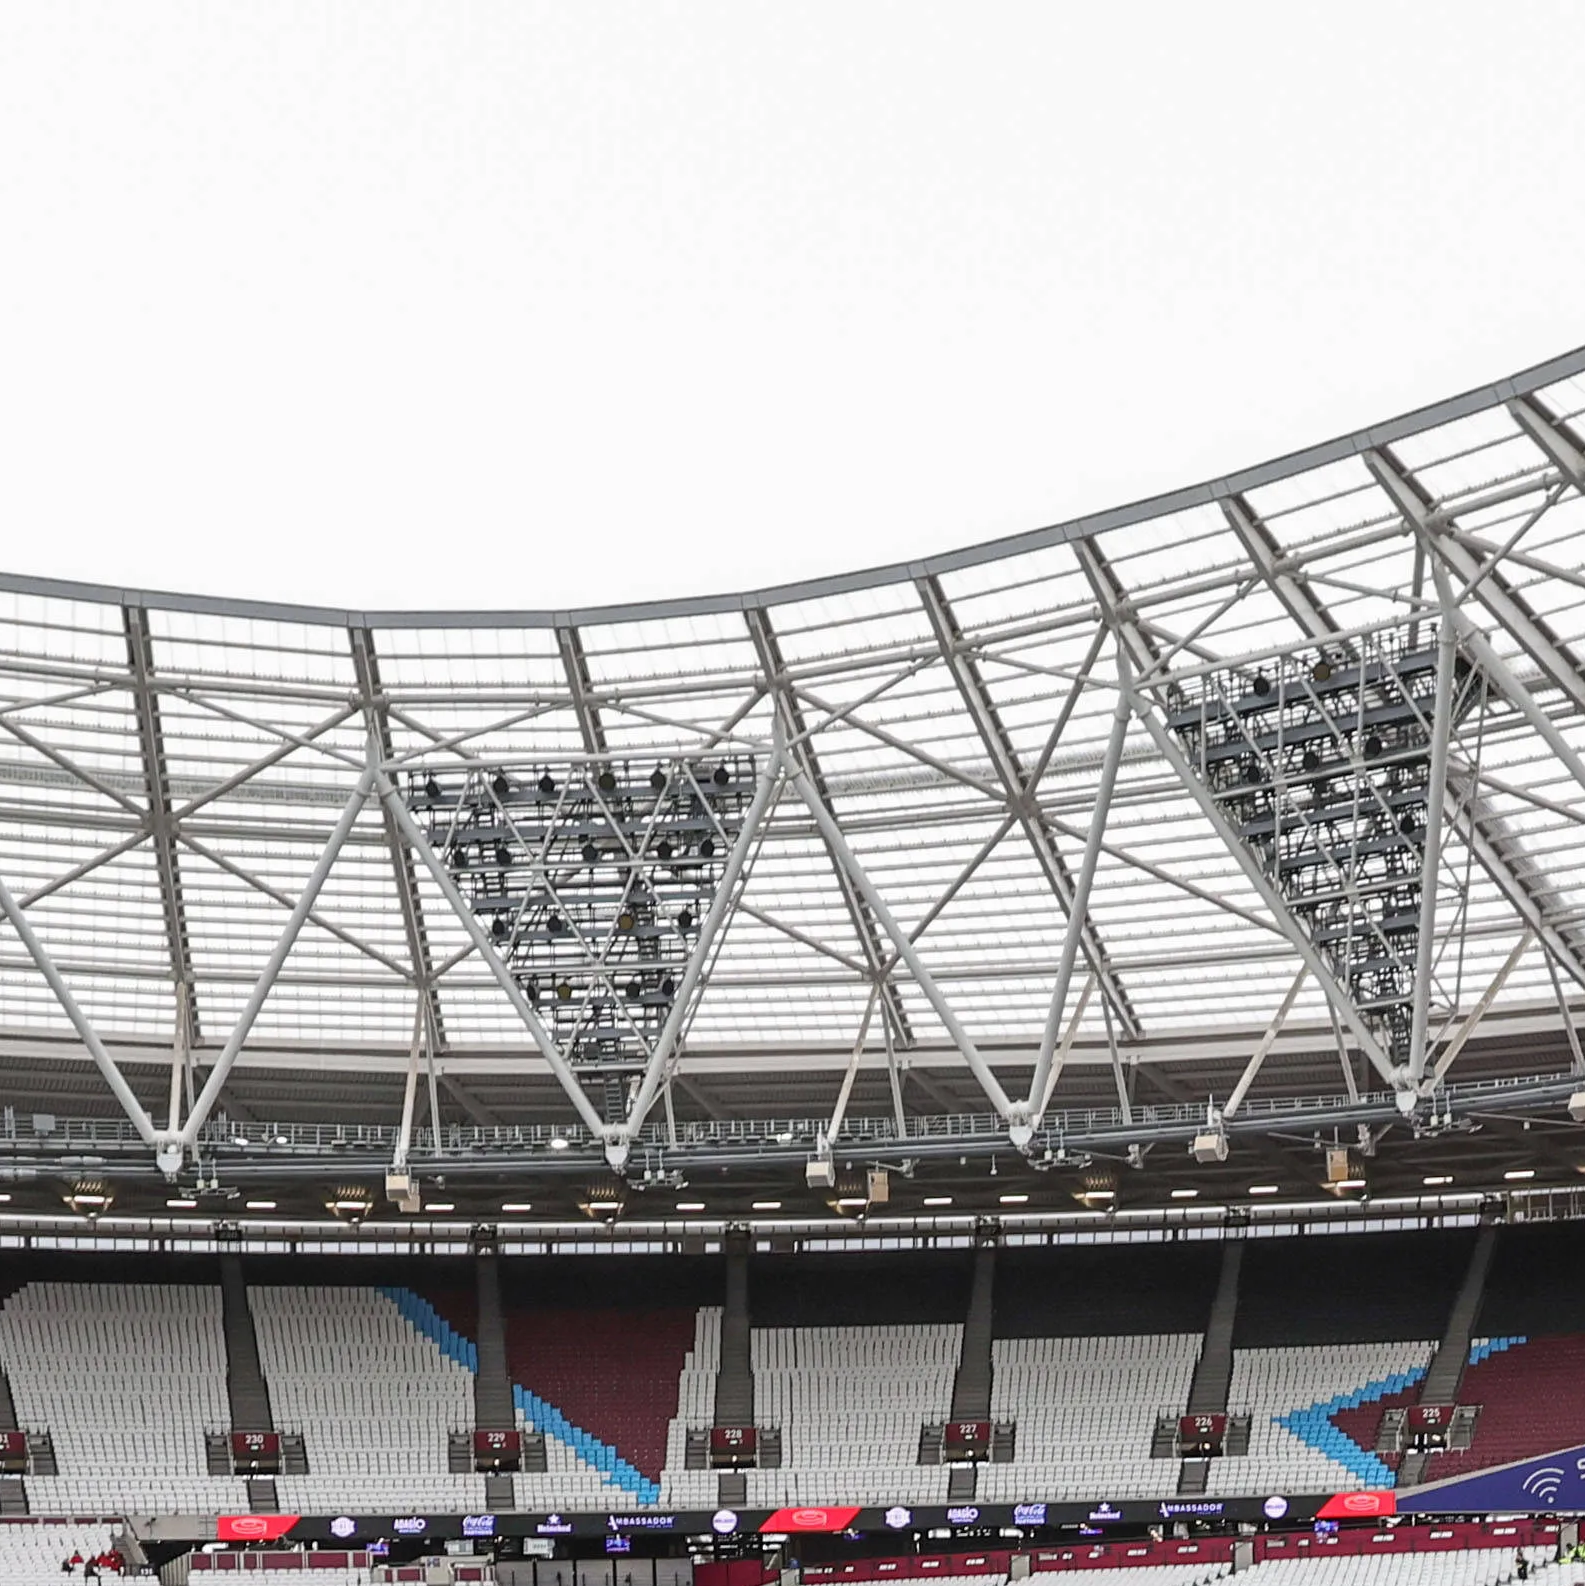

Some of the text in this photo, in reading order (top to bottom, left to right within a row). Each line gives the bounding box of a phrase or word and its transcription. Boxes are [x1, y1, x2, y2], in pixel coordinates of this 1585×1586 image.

[1422, 1408, 1441, 1418] 225
[1195, 1417, 1213, 1427] 226
[725, 1429, 743, 1439] 228
[960, 1424, 978, 1434] 227
[245, 1434, 264, 1445] 230
[488, 1433, 506, 1443] 229
